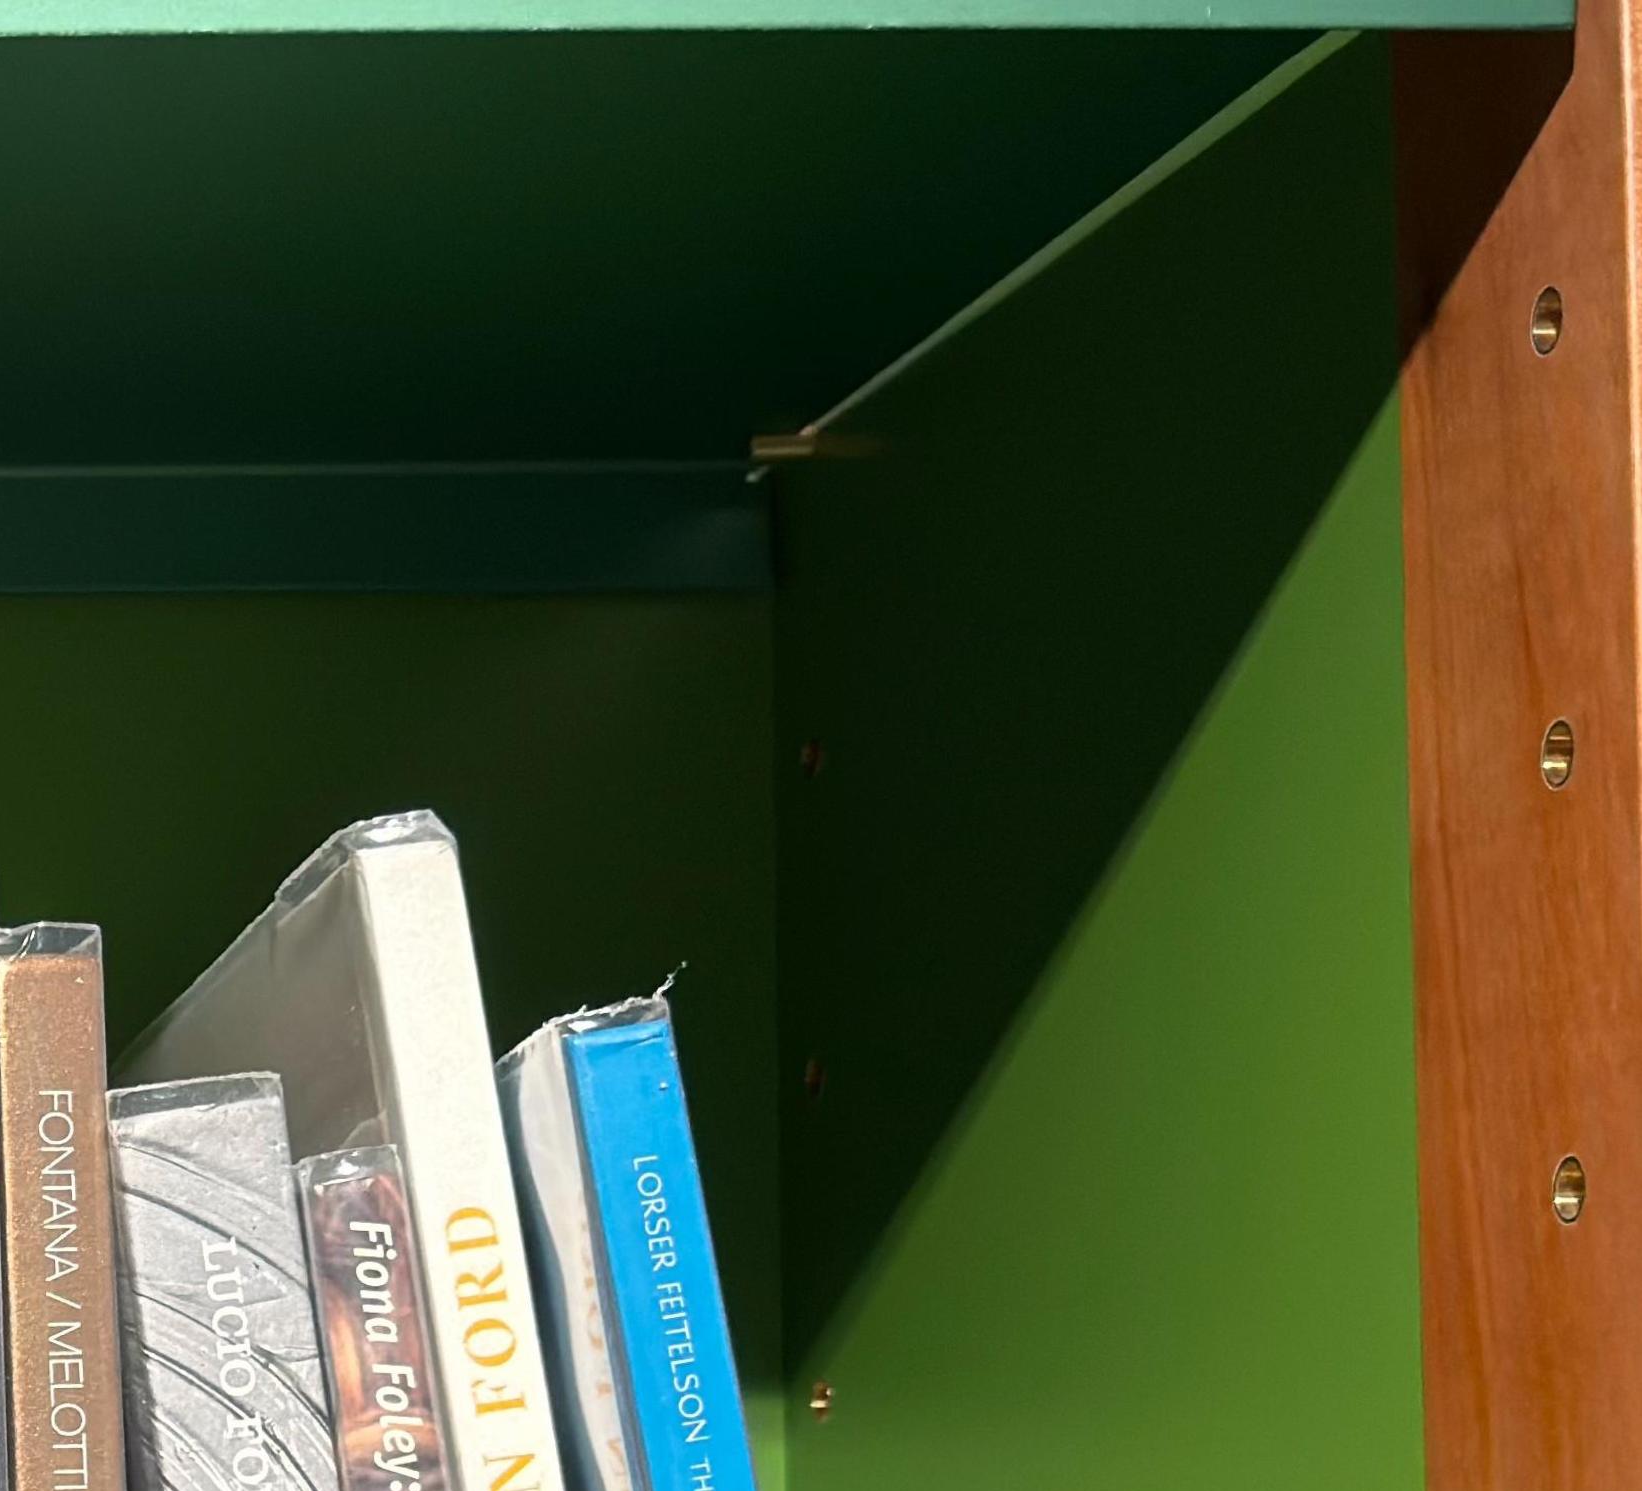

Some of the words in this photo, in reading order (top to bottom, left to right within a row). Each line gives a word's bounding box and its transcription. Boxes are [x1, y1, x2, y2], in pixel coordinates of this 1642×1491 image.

[38, 1089, 81, 1283] FONTANA
[201, 1237, 253, 1400] LUCIO
[348, 1219, 400, 1346] Fiona
[444, 1204, 528, 1418] FORD
[632, 1154, 678, 1271] LORSER
[656, 1280, 708, 1444] FEITELSON
[47, 1321, 89, 1491] MELOTTI
